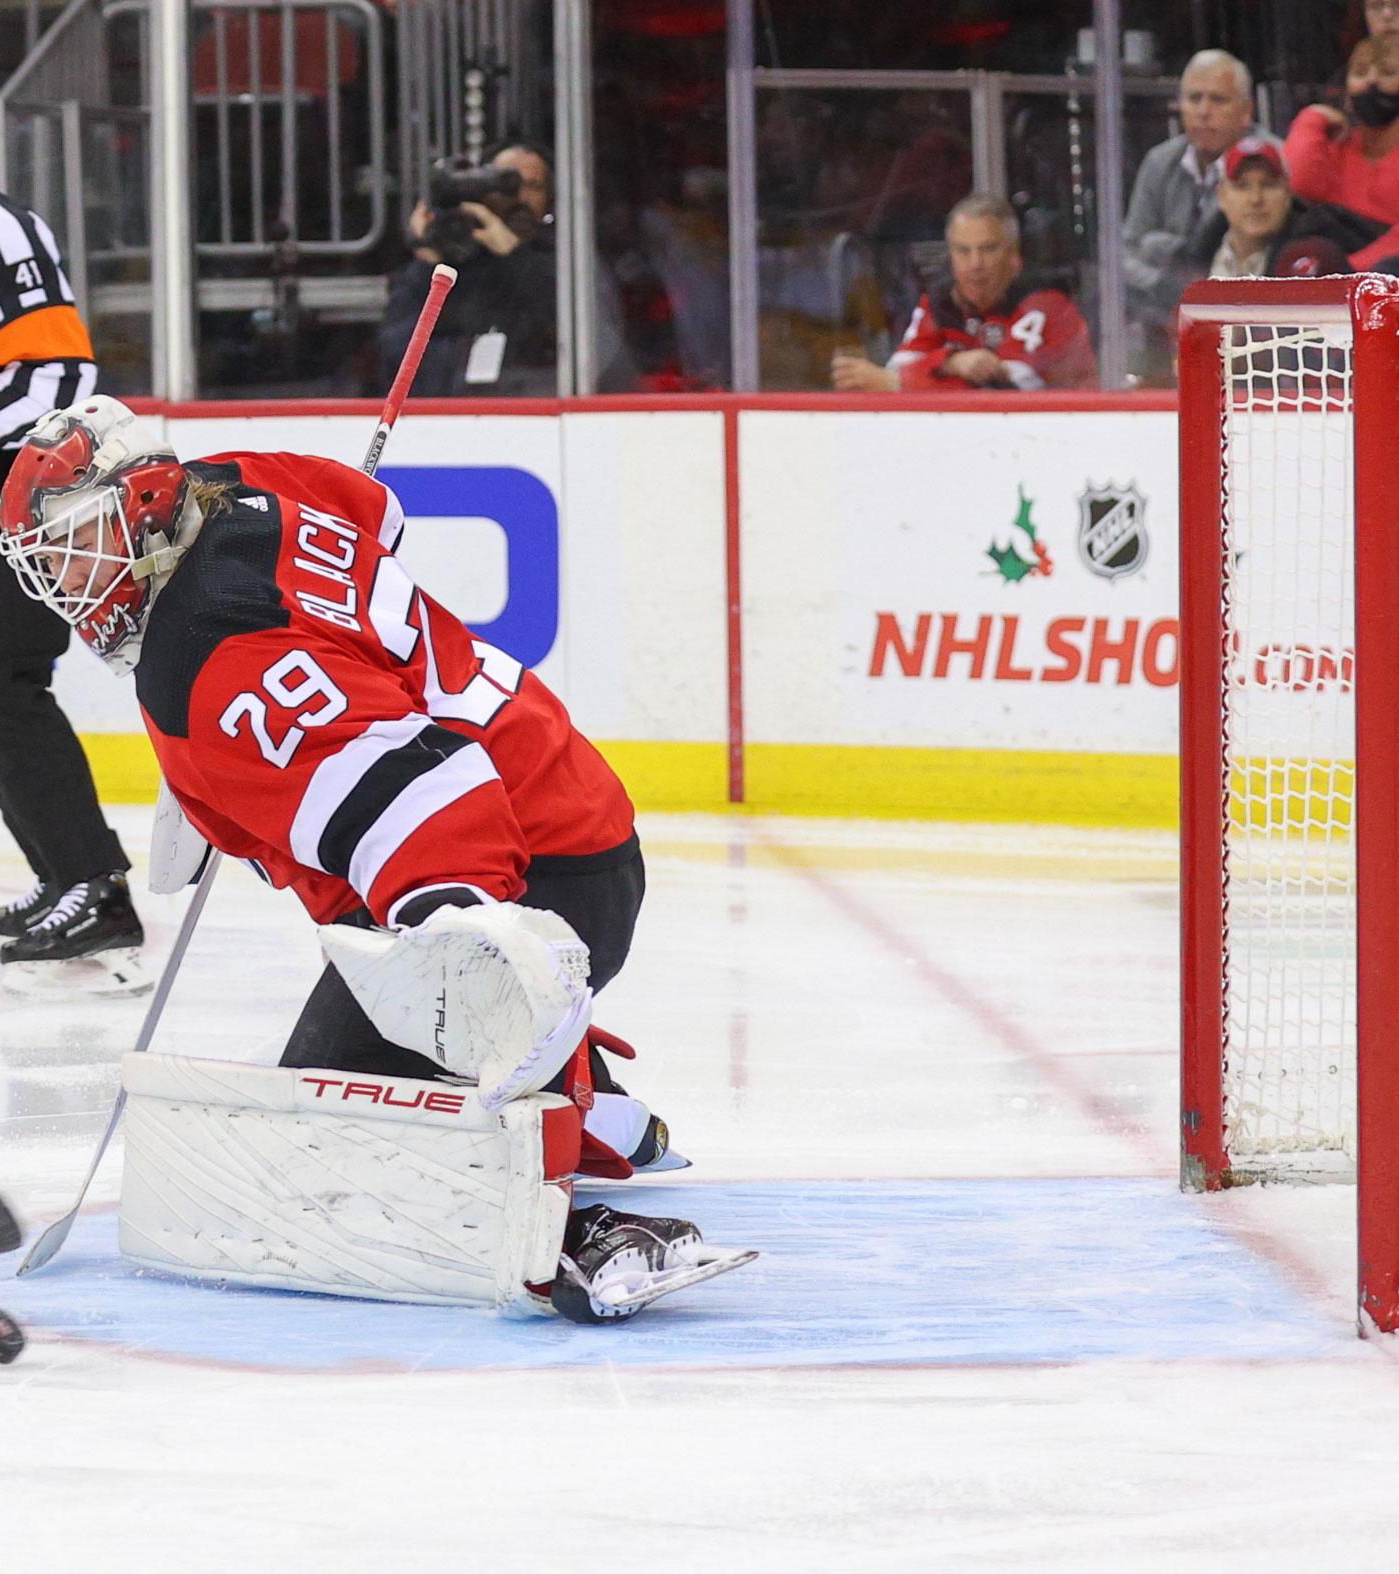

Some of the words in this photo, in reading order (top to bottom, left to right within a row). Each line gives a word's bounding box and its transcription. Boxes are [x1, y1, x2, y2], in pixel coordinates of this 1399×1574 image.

[15, 260, 43, 288] 41
[218, 648, 349, 770] 29
[434, 988, 447, 1064] TRUE
[301, 1076, 467, 1115] TRUE
